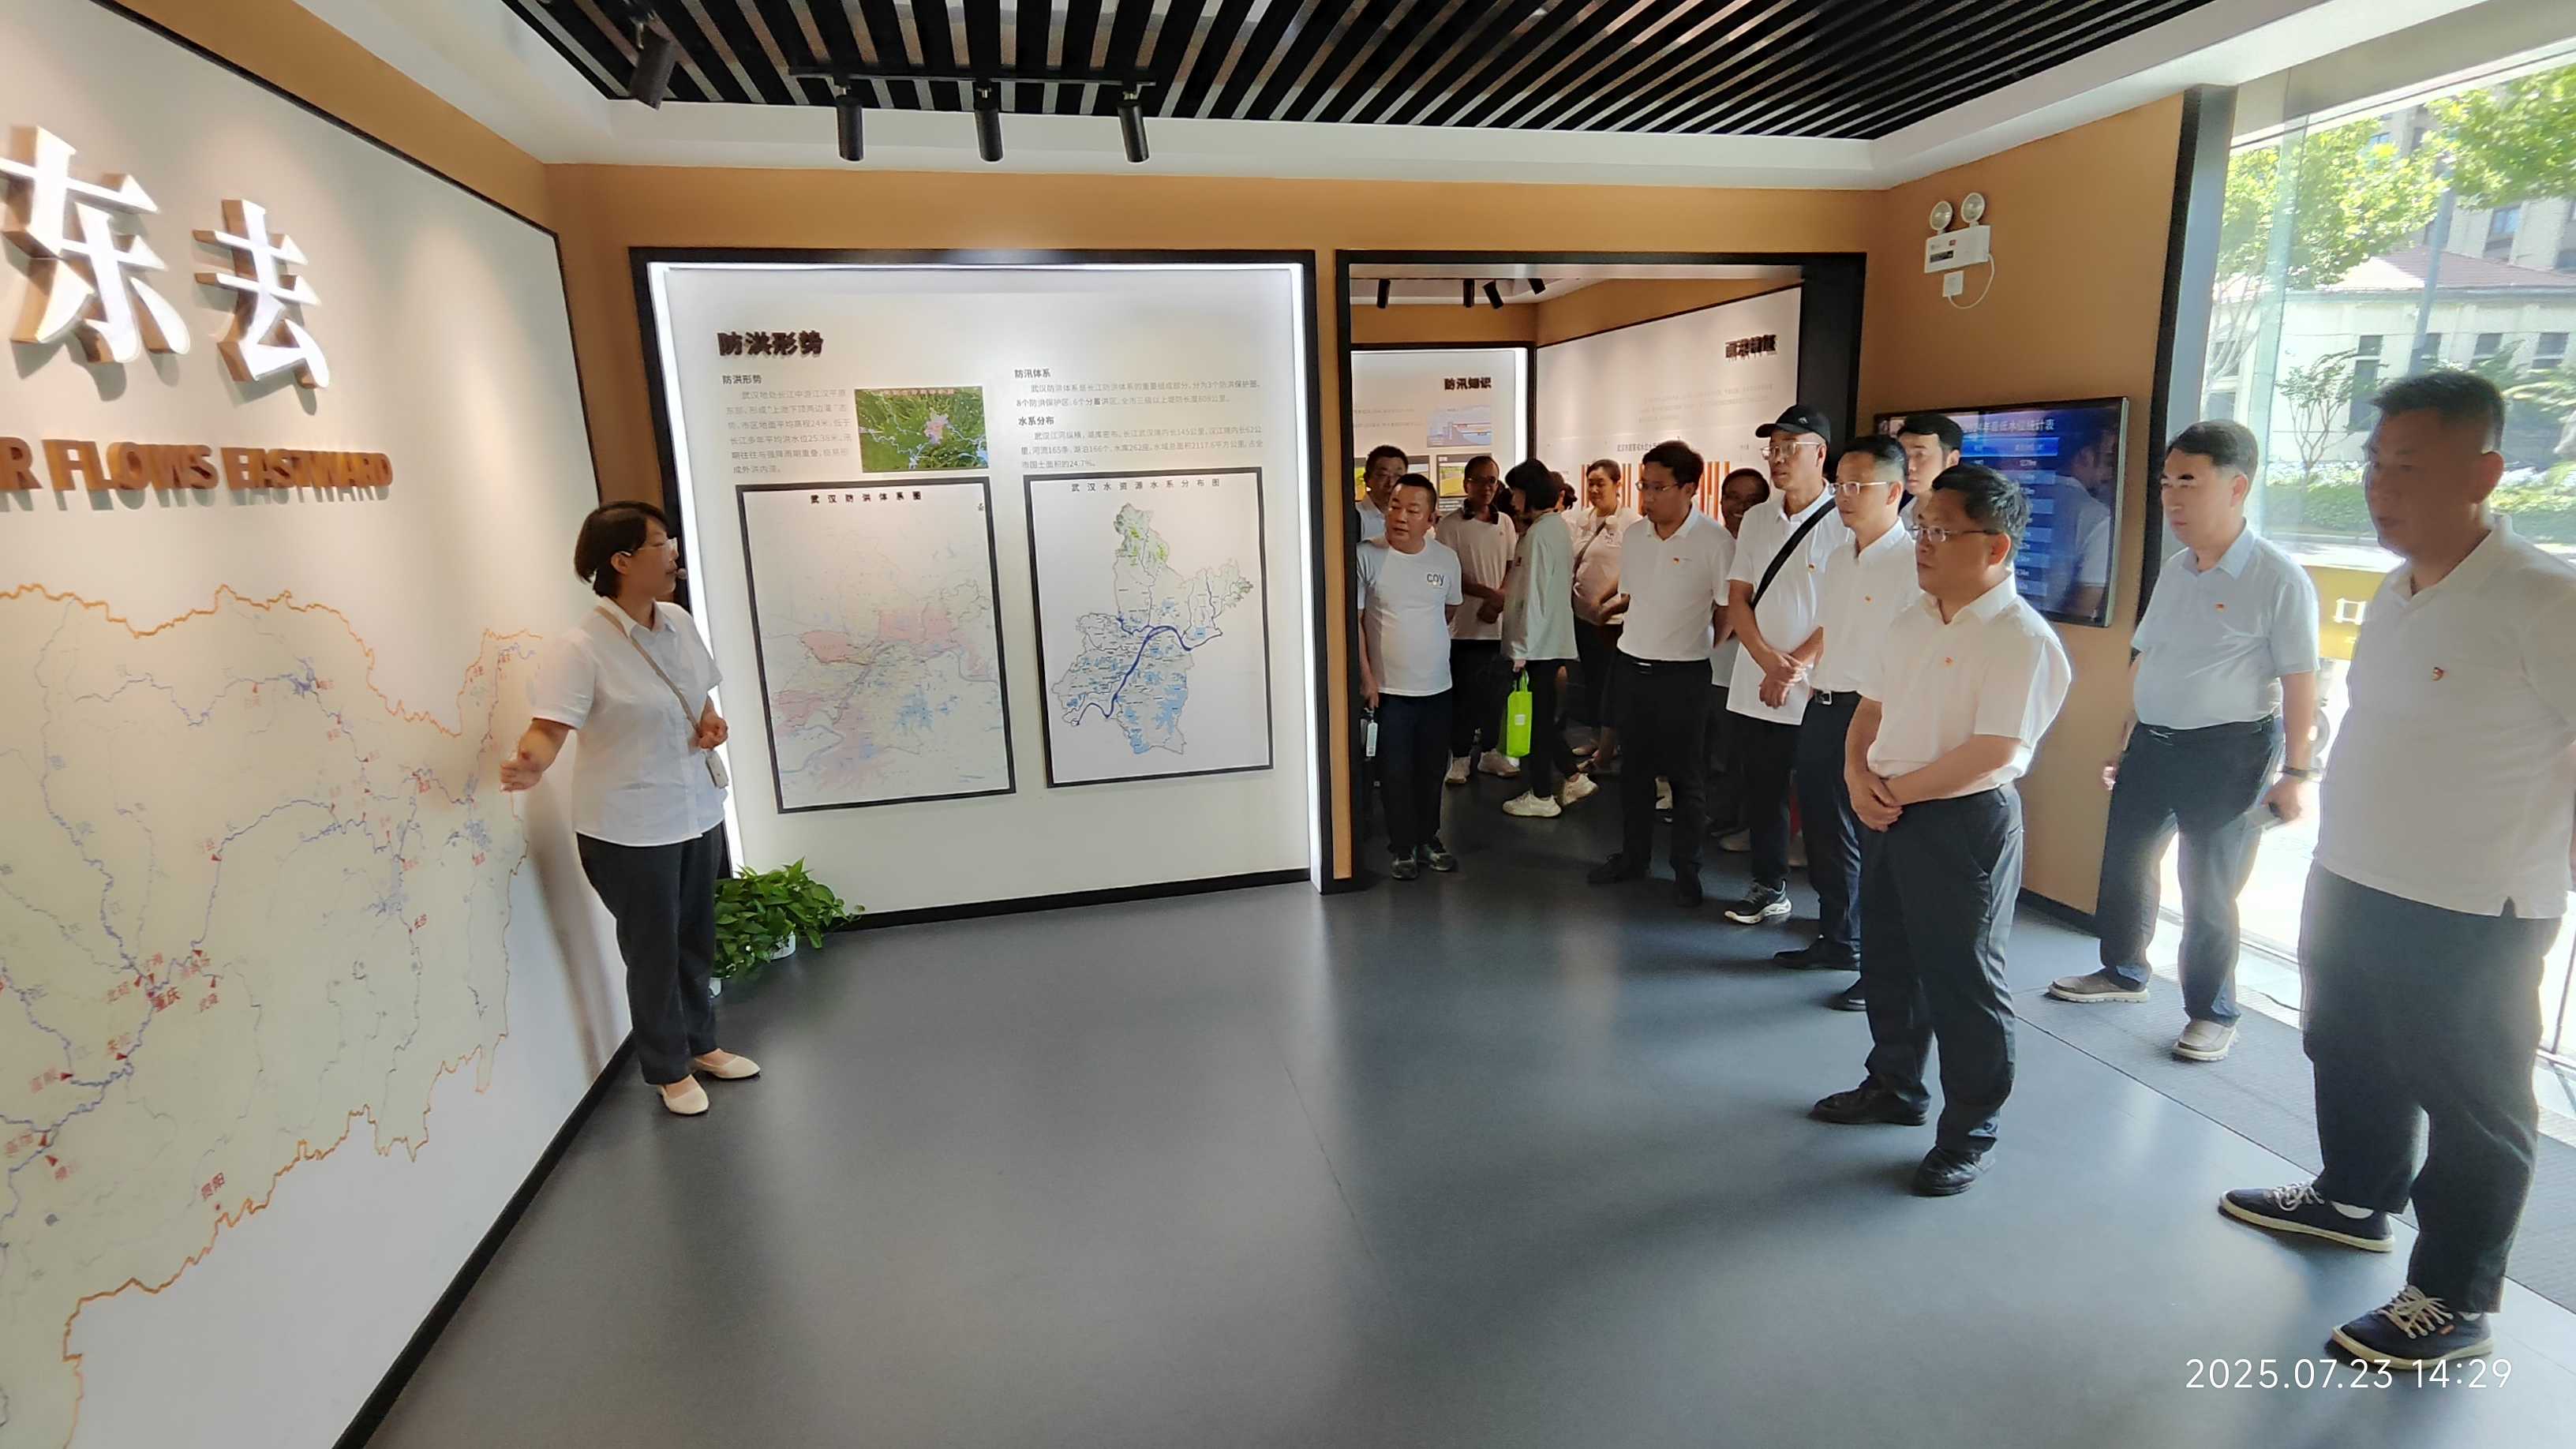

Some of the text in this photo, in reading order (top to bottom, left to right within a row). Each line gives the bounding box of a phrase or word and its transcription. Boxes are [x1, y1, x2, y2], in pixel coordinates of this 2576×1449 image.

[0, 125, 330, 388] 东去
[717, 331, 824, 356] 防洪形势
[722, 375, 762, 385] 防洪形势
[1014, 369, 1051, 379] 防汛体系
[1443, 376, 1492, 391] 防汛知识
[1018, 416, 1055, 426] 水系分布
[42, 439, 219, 491] FLOWS
[221, 447, 393, 490] EASTWARD
[1071, 478, 1221, 492] 武汉水资源水系分布图
[811, 490, 923, 505] 武汉防洪体系图
